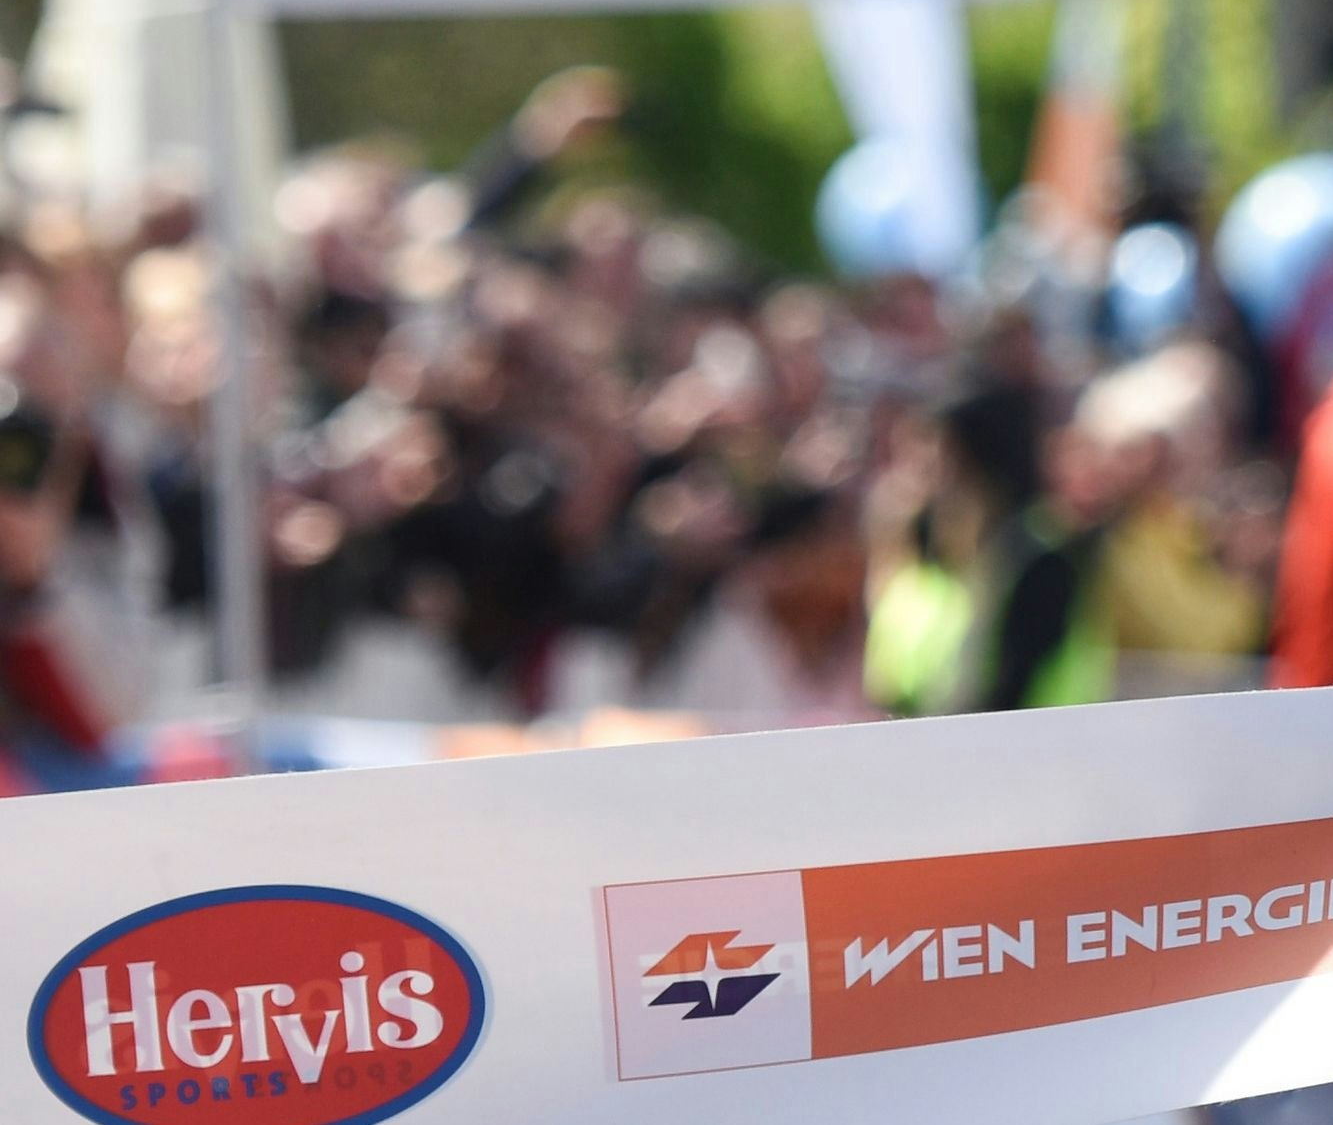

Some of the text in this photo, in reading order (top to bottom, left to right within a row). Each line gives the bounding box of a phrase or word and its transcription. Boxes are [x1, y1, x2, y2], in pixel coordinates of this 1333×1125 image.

[843, 920, 1037, 990] WIEN
[78, 951, 444, 1085] Hervis
[120, 1070, 288, 1111] SPORTS
